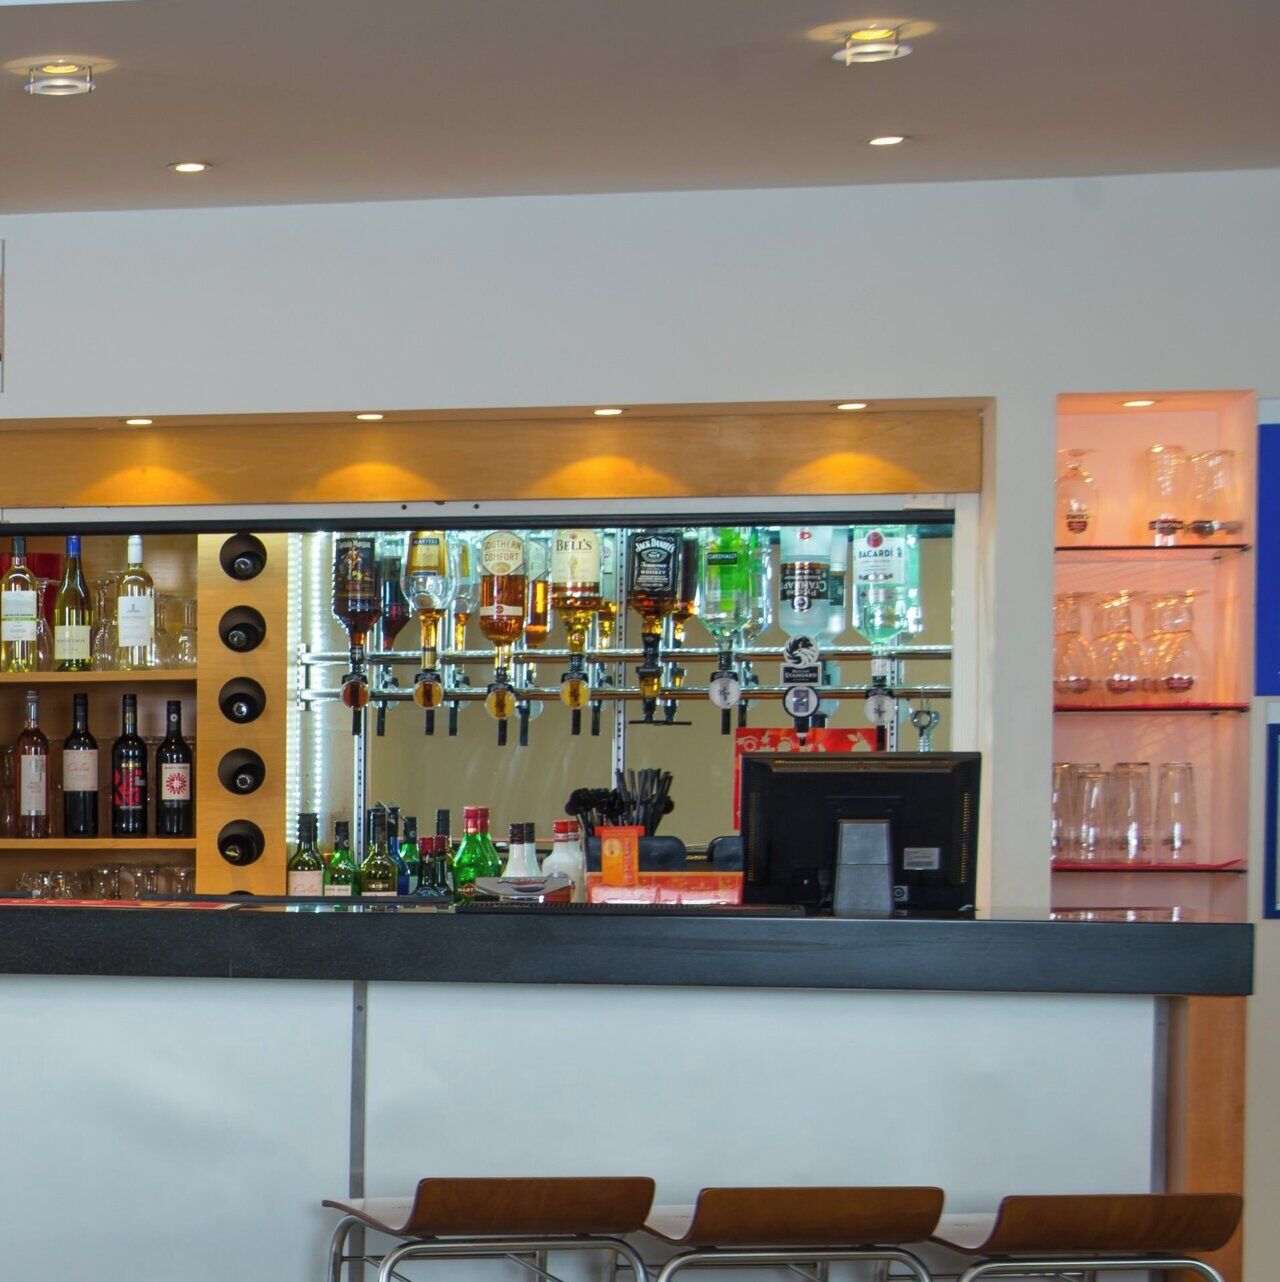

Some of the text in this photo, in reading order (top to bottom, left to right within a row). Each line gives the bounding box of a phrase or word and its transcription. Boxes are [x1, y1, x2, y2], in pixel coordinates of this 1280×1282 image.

[483, 540, 522, 550] SOUTHERN
[484, 552, 520, 562] COMFORT
[785, 671, 818, 679] STANDARD
